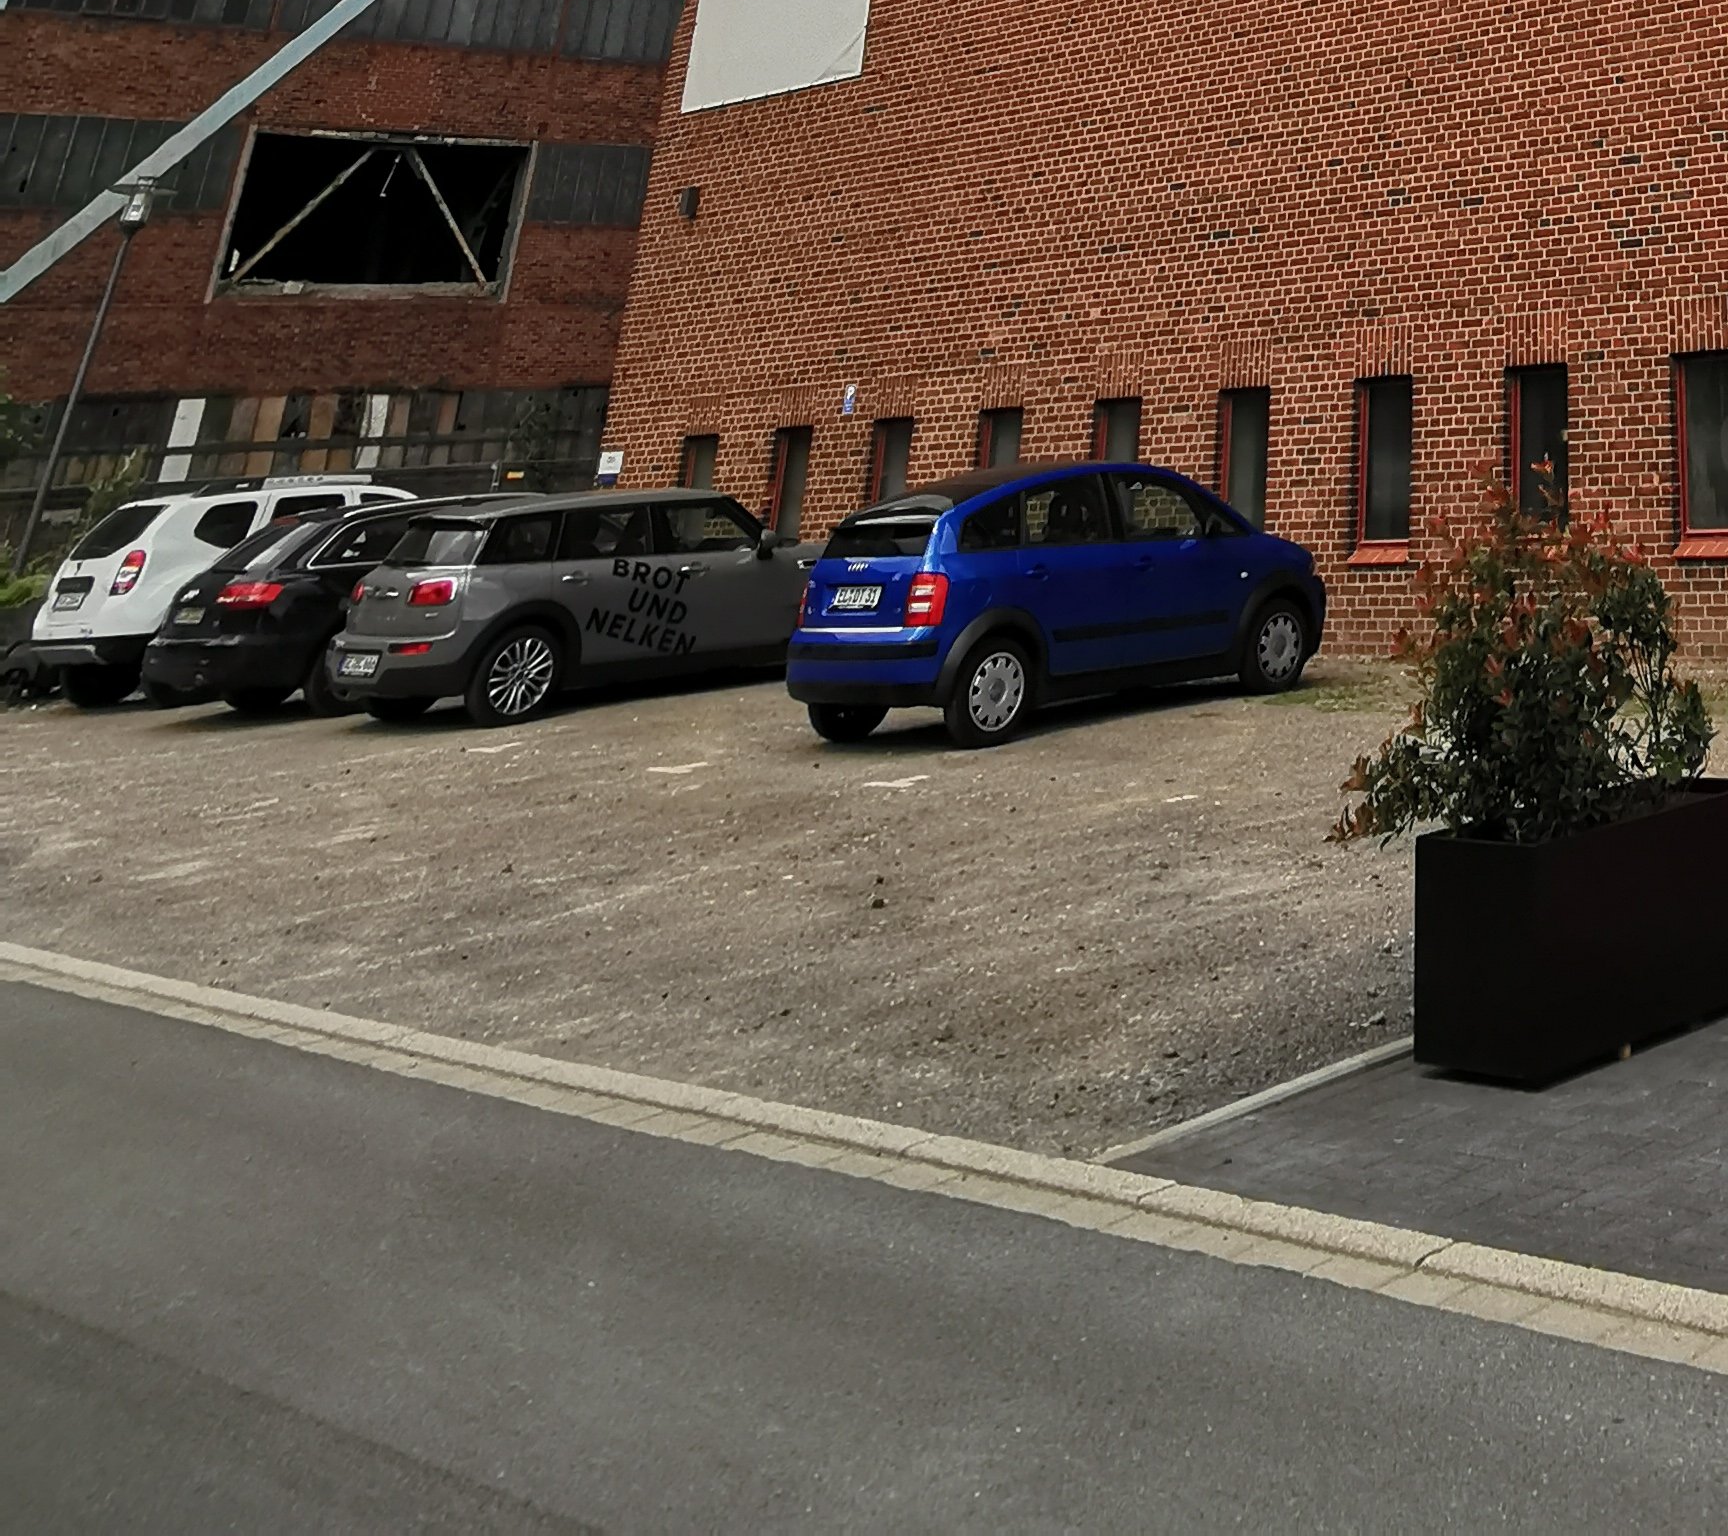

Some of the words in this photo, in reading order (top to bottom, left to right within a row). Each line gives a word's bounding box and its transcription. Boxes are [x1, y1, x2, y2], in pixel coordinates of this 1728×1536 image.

[613, 559, 690, 594] BROT
[628, 588, 688, 625] UND
[586, 608, 697, 655] NELKEN
